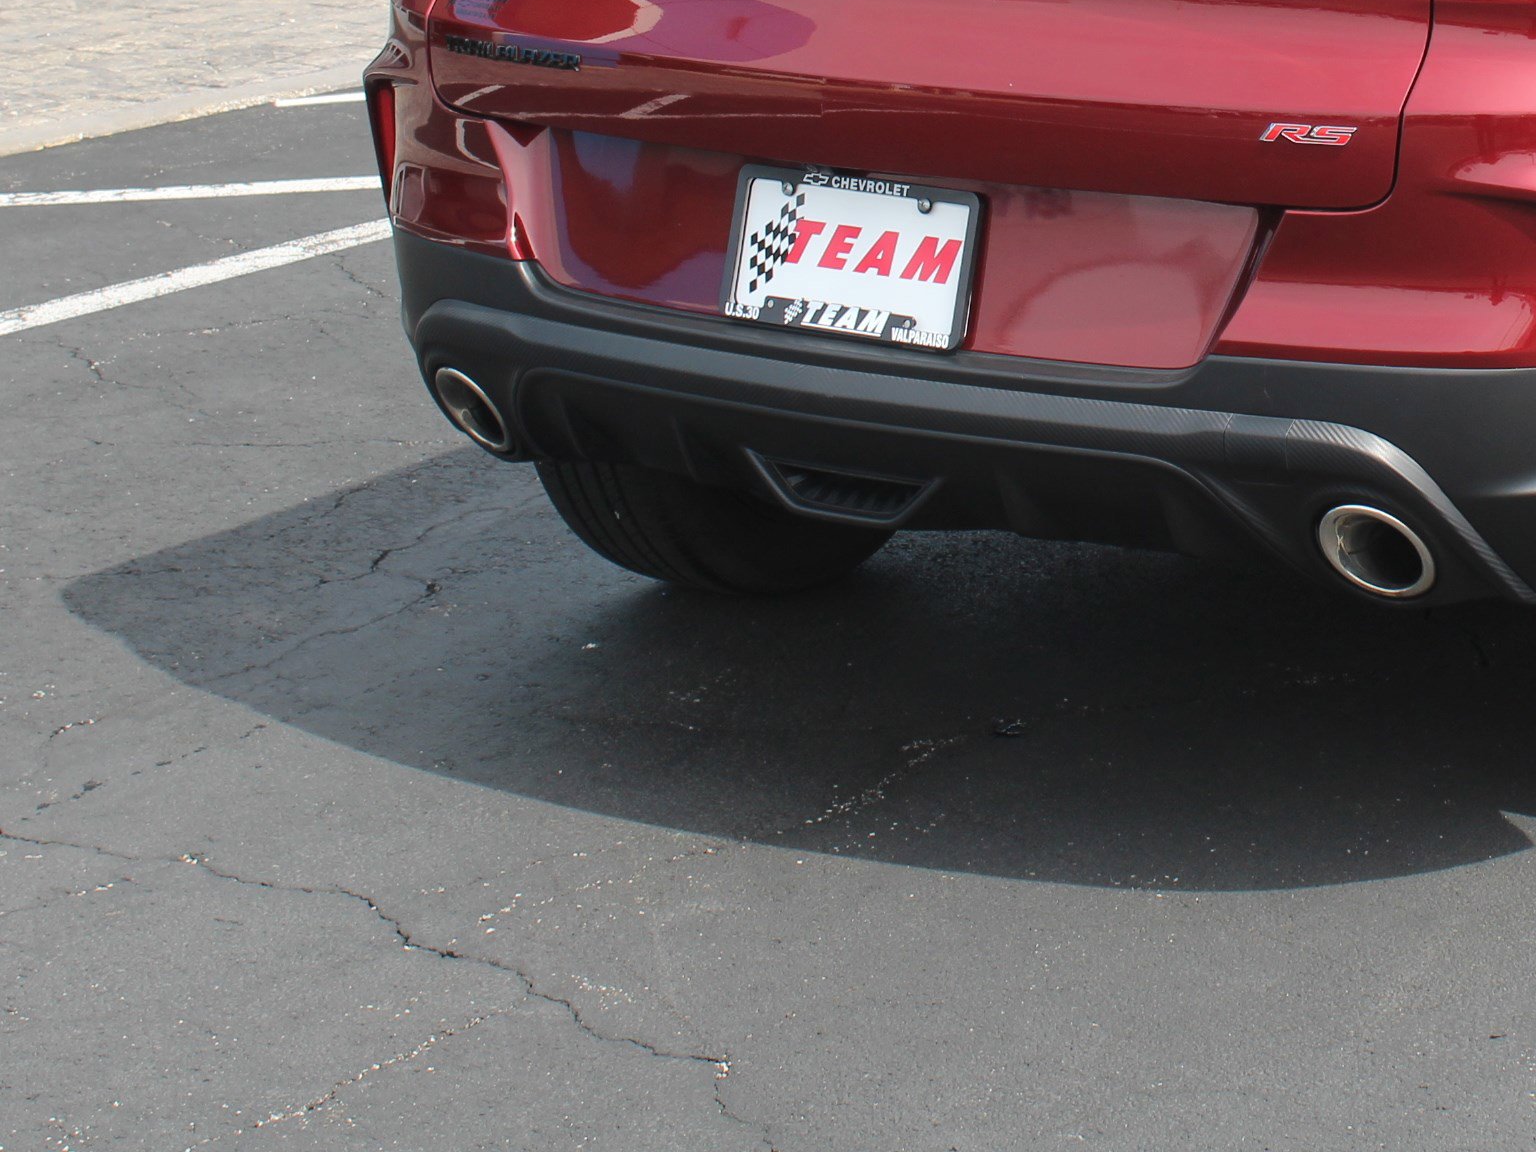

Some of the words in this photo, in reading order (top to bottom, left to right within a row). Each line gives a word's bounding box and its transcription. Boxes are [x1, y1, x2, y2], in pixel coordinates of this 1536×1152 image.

[1259, 123, 1357, 146] RS
[831, 176, 910, 197] CHEVROLET
[784, 219, 963, 284] TEAM
[802, 301, 892, 335] TEAM
[890, 327, 950, 349] VALPARAISO
